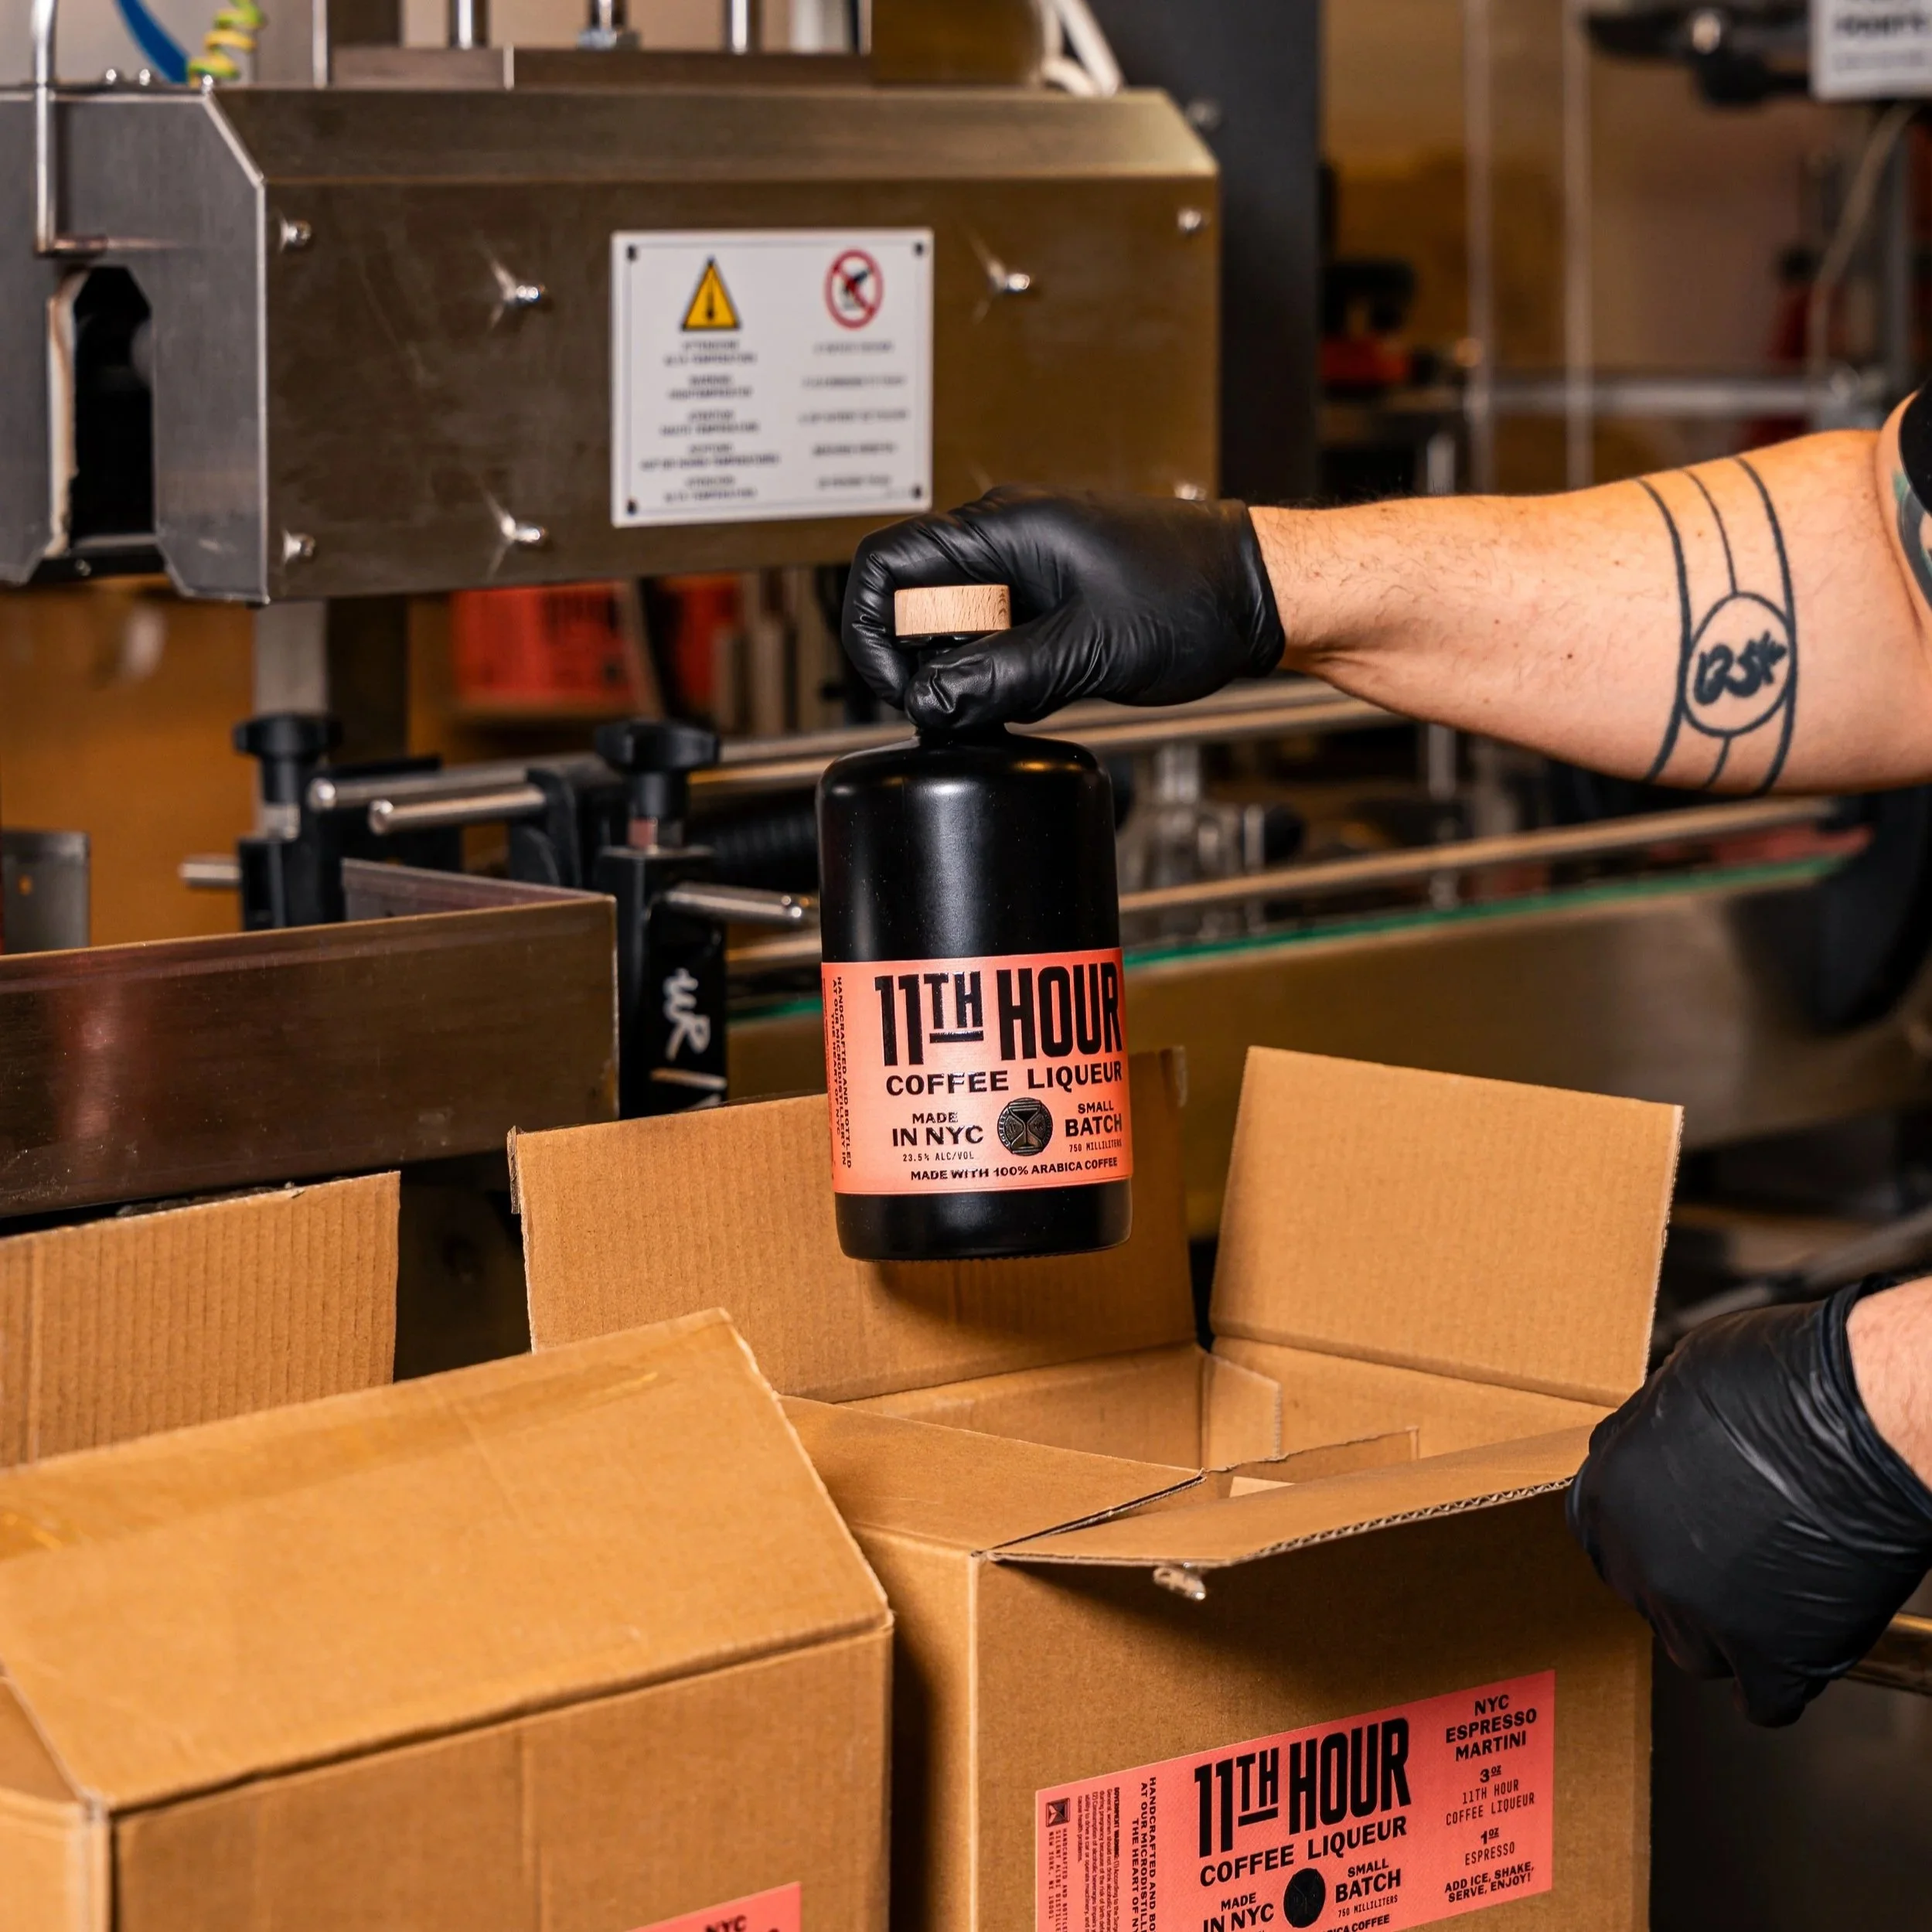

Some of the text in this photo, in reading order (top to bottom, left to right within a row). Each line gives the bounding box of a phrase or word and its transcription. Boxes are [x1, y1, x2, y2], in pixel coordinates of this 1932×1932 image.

[837, 976, 847, 1074] HANDCRAFTED
[874, 962, 1123, 1066] 11TH HOUR
[833, 980, 837, 994] AT
[836, 1028, 846, 1148] MICRODISTILLERY
[842, 1152, 847, 1165] IN
[886, 1061, 1123, 1095] COFFEE LIQUEUR
[912, 1112, 958, 1124] MADE
[1078, 1101, 1114, 1114] SMALL
[892, 1125, 983, 1147] IN NYC
[1065, 1113, 1123, 1137] BATCH
[903, 1151, 974, 1162] 23.5% ALC/VOL
[1069, 1139, 1123, 1153] 750 MILLILITERS
[911, 1157, 1118, 1181] MADE WITH 100% ARABICA COFFEE
[1474, 1694, 1509, 1716] NYC
[1446, 1709, 1537, 1743] ESPRESSO
[1455, 1730, 1526, 1761] MARTINI
[1140, 1782, 1148, 1797] AT
[1194, 1718, 1412, 1858] 11TH HOUR
[1463, 1779, 1519, 1804] 11TH HOUR
[1446, 1792, 1535, 1825] COFFEE LIQUEUR
[1200, 1816, 1407, 1886] COFFEE LIQUEUR
[1465, 1842, 1515, 1866] ESPRESSO
[1348, 1858, 1389, 1878] SMALL
[1445, 1862, 1534, 1893] ADD ICE, SHAKE,
[1335, 1868, 1401, 1903] BATCH
[1448, 1872, 1531, 1903] SERVE, ENJOY!
[1132, 1896, 1139, 1914] OF
[1221, 1892, 1257, 1911] MADE
[1337, 1894, 1398, 1918] 750 MILLILITERS
[1203, 1903, 1274, 1932] IN NYC
[1351, 1913, 1390, 1932] COFFEE
